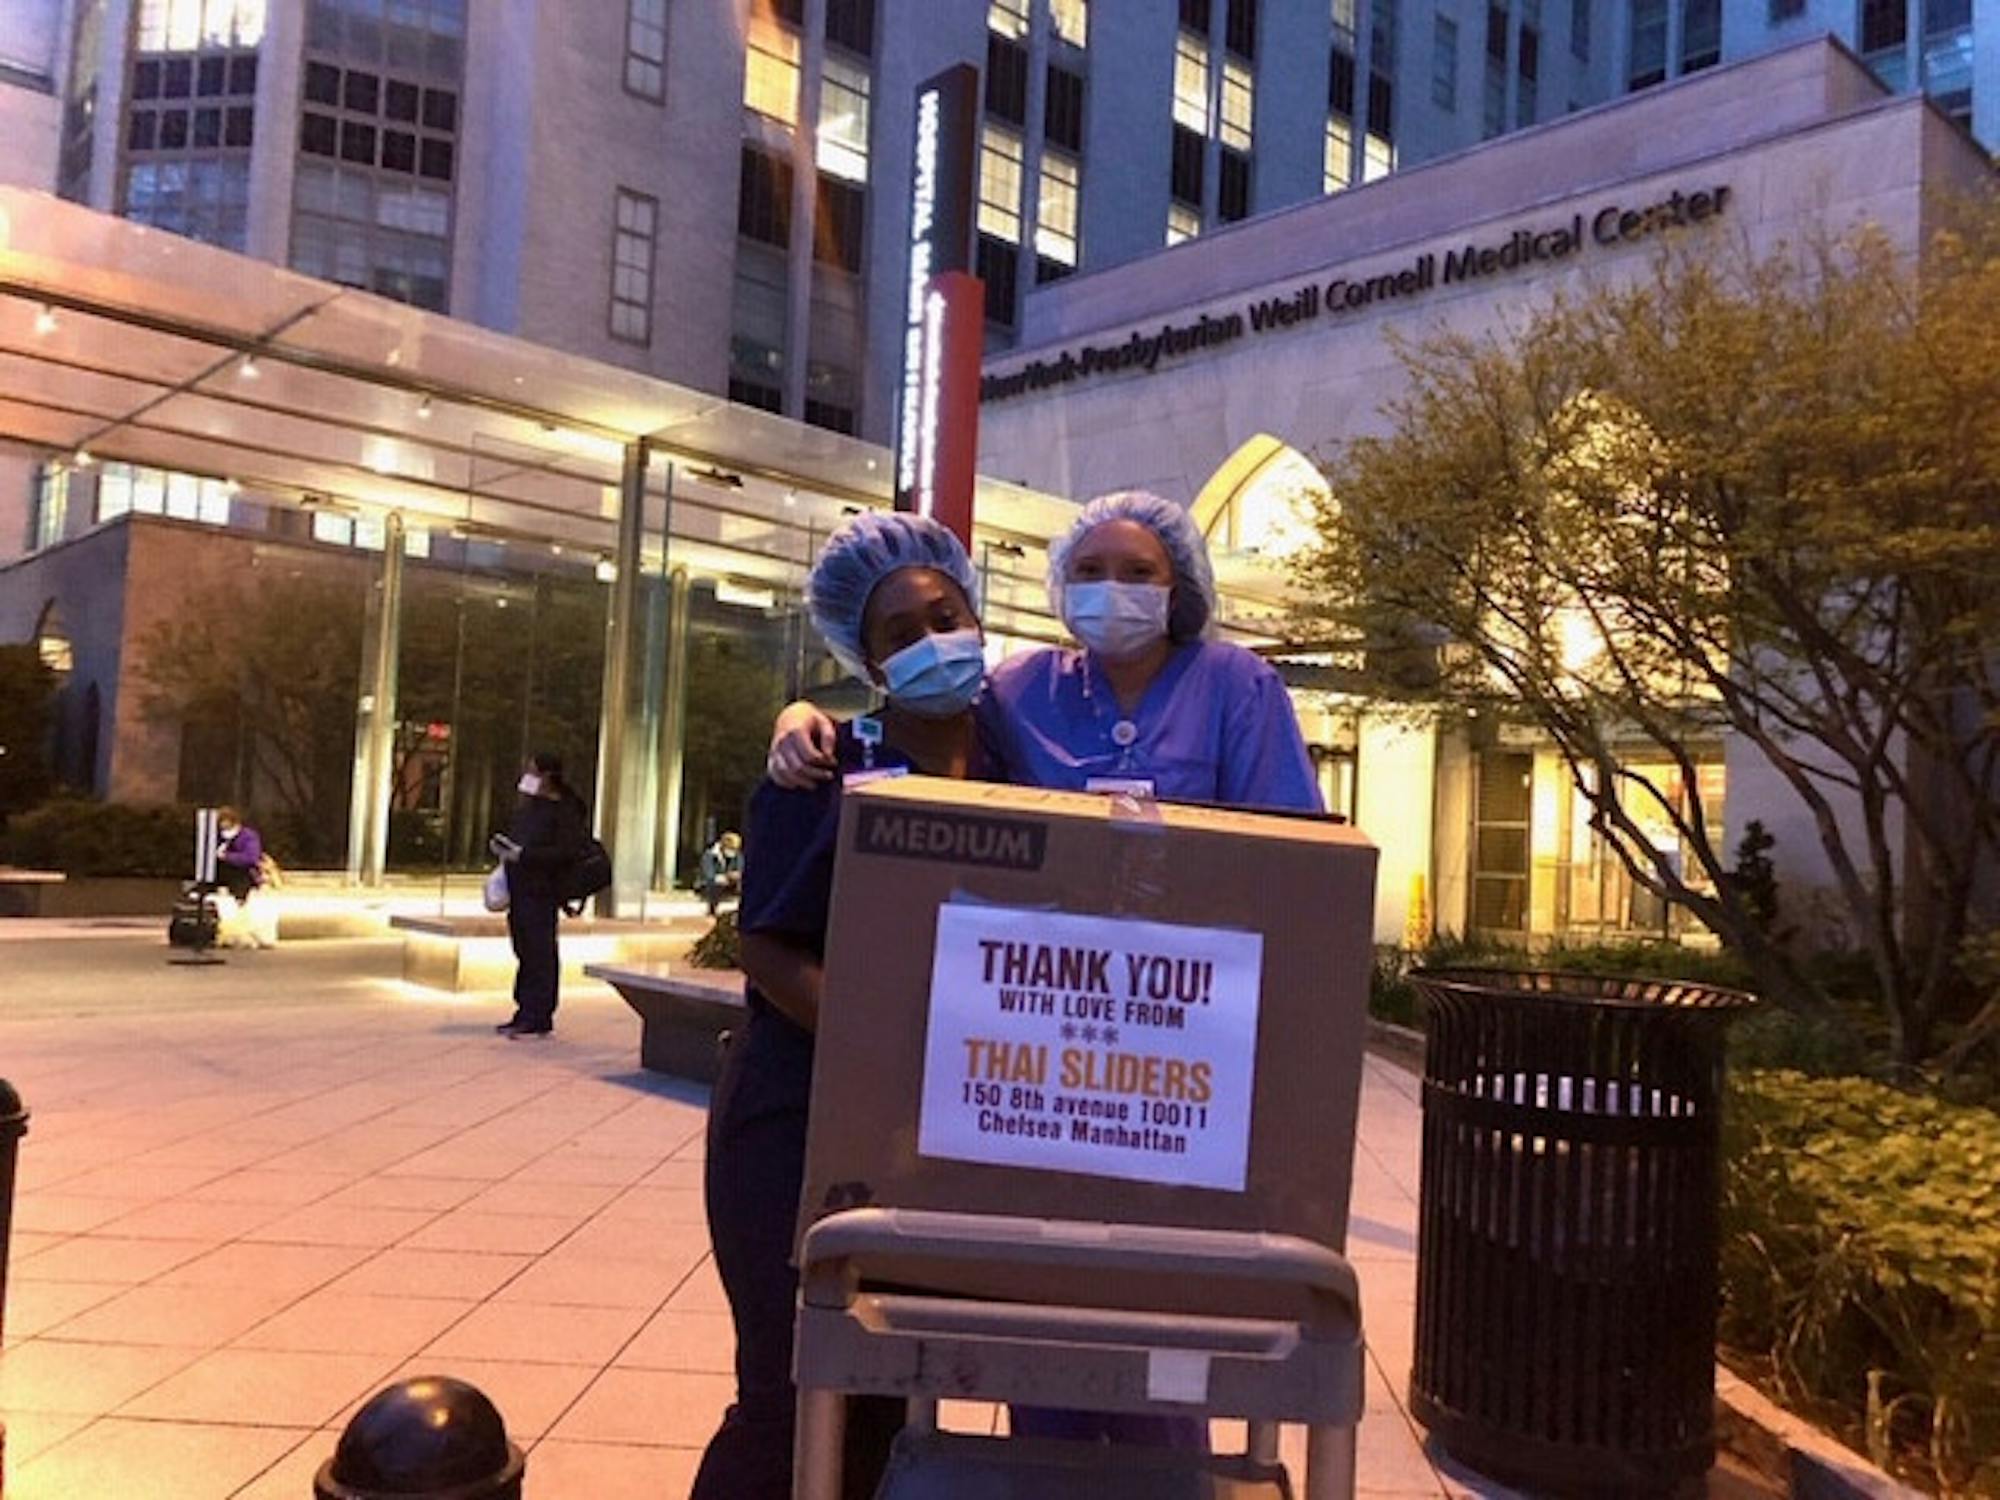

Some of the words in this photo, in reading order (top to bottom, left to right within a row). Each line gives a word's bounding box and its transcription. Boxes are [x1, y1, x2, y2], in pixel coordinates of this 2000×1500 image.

[1248, 285, 1318, 332] Weill
[1326, 254, 1435, 313] Cornell
[1443, 215, 1582, 283] Medical
[1592, 185, 1732, 245] Center
[869, 814, 1031, 862] MEDIUM
[978, 939, 1110, 995] THANK
[1125, 952, 1213, 1005] YOU!
[999, 988, 1054, 1016] WITH
[1063, 994, 1115, 1022] LOVE
[1124, 1000, 1185, 1029] FROM
[963, 1039, 1047, 1085] THAI
[1060, 1047, 1213, 1104] SLIDERS
[962, 1081, 1002, 1108] 150
[1010, 1086, 1044, 1112] 8th
[1053, 1096, 1129, 1122] avenue
[1141, 1101, 1208, 1129] 10011
[978, 1108, 1062, 1140] Chelsea
[1072, 1118, 1187, 1154] Manhattan
